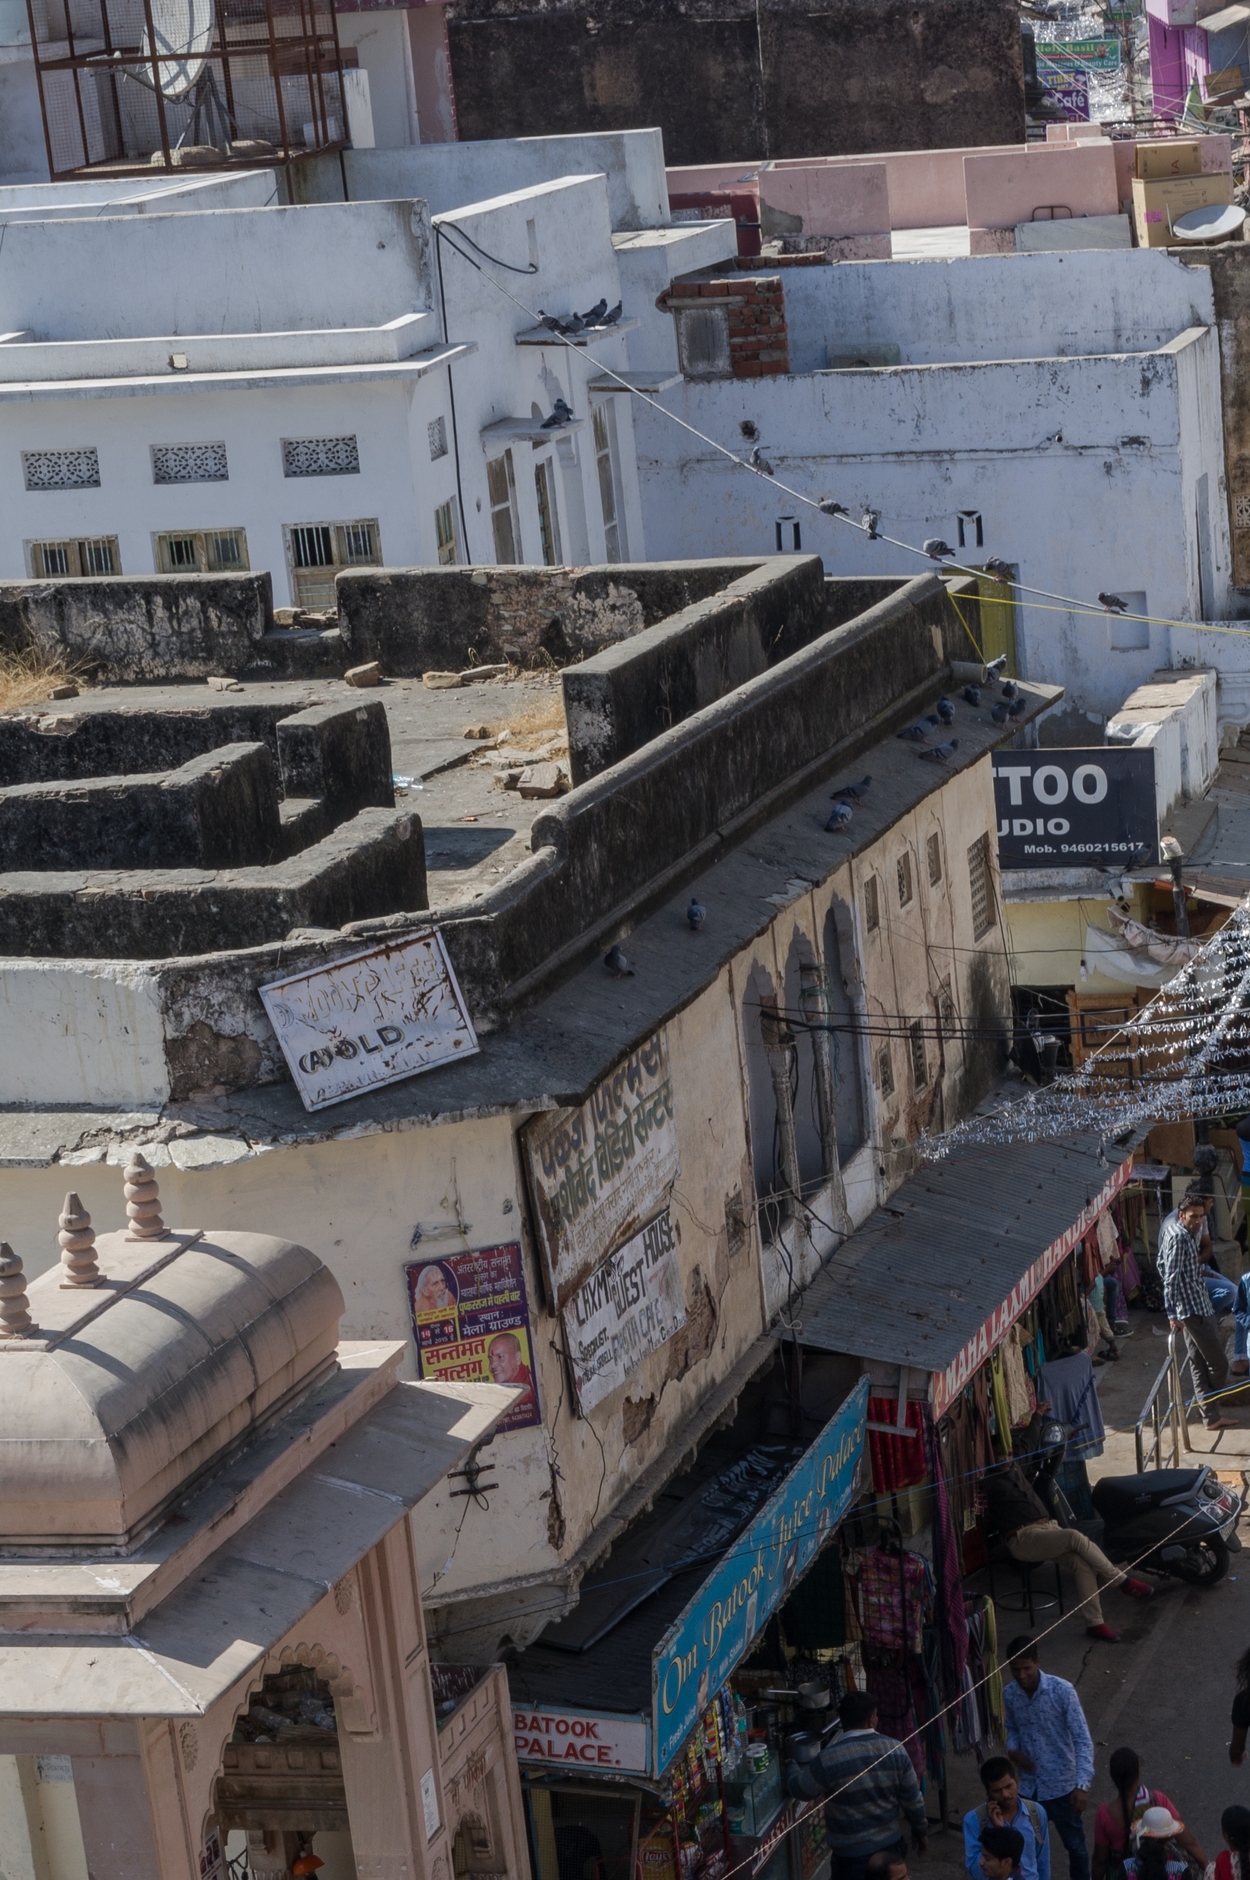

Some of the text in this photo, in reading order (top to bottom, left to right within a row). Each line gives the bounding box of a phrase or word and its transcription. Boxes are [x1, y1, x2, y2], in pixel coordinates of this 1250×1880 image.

[1065, 43, 1094, 52] Basil
[1024, 841, 1144, 854] Mob. 9460215617
[642, 1210, 676, 1270] HOUSE
[461, 1323, 486, 1337] मेला
[945, 1322, 989, 1405] MAHA
[662, 1642, 698, 1717] Om
[702, 1542, 766, 1663] Batook
[768, 1488, 814, 1582] Juice
[816, 1414, 867, 1508] Palace
[514, 1713, 599, 1739] BATOOK
